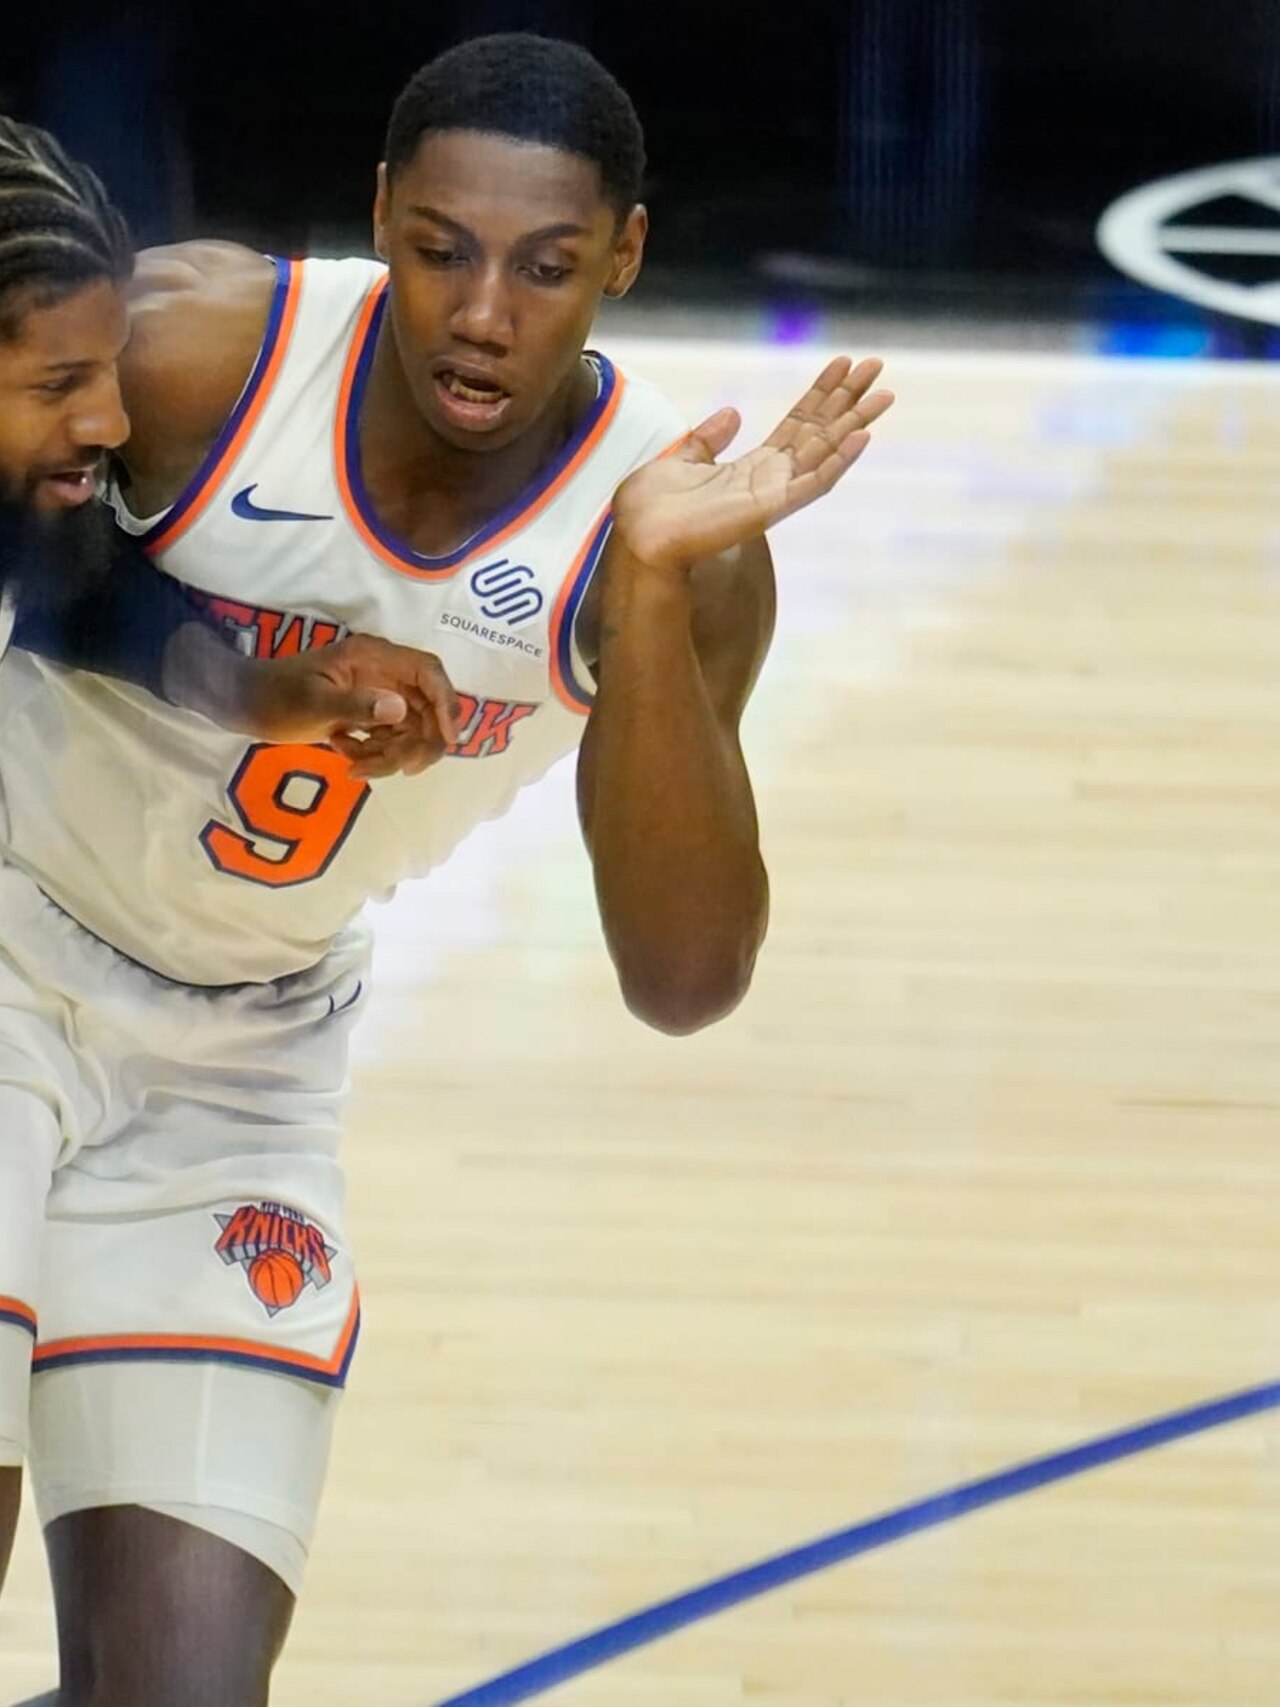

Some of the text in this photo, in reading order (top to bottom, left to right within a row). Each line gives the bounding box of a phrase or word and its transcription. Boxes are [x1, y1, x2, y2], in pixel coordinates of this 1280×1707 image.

[440, 612, 544, 658] SQUARESPACE
[198, 741, 373, 889] 9
[214, 1203, 333, 1291] KNICKS
